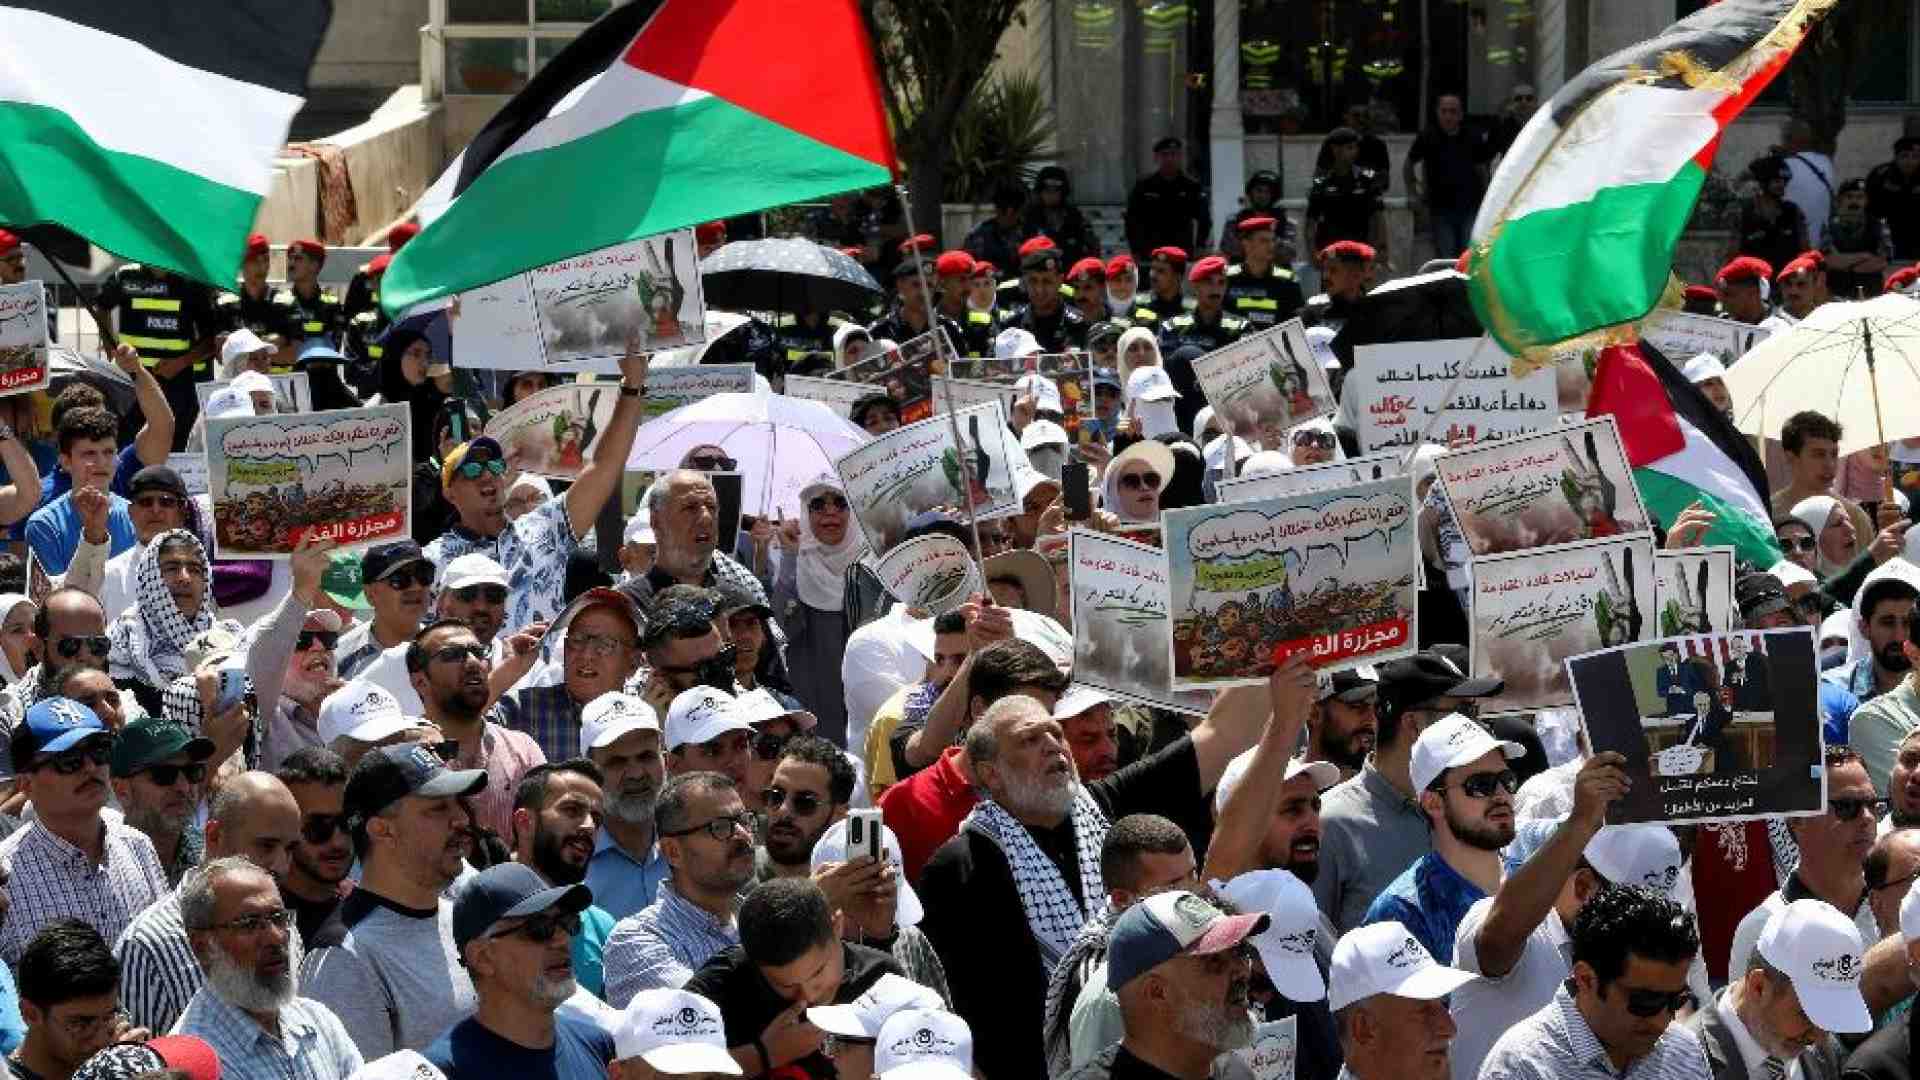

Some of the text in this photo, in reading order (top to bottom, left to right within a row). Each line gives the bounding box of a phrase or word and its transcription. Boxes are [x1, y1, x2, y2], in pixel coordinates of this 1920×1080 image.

[147, 316, 177, 330] POLICE
[348, 516, 397, 538] مجزرة
[1342, 624, 1401, 653] مجزرة
